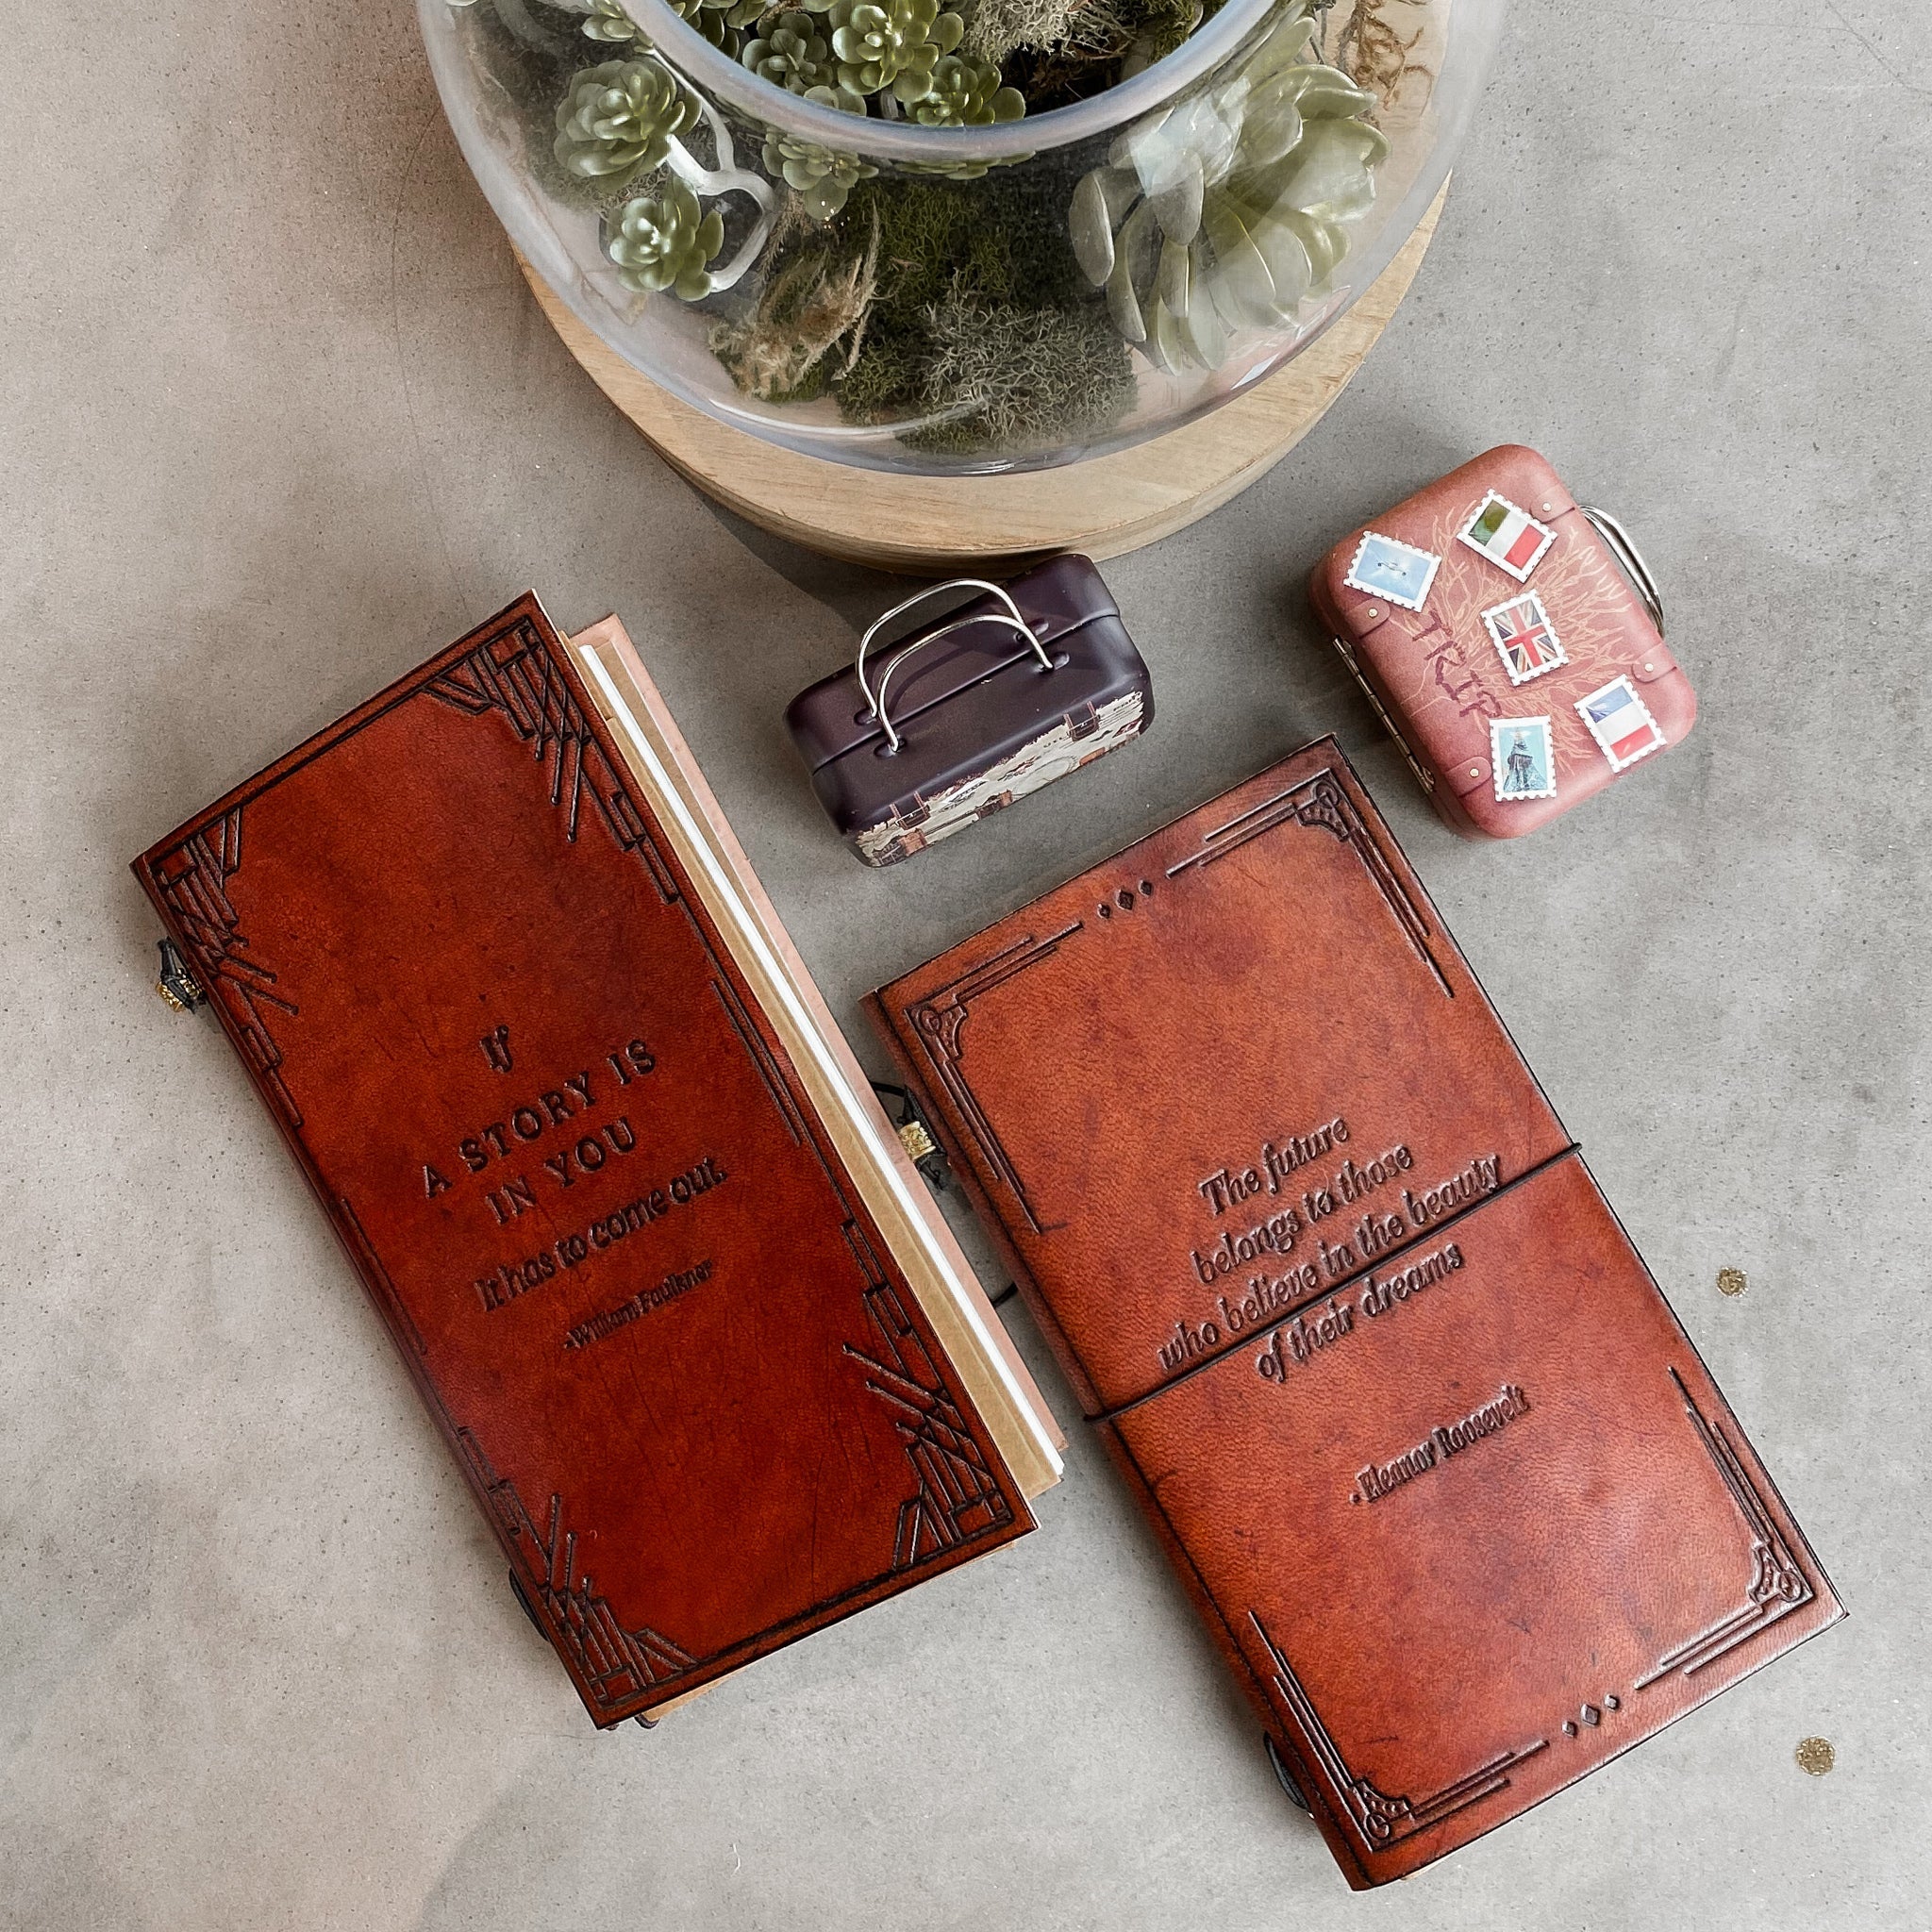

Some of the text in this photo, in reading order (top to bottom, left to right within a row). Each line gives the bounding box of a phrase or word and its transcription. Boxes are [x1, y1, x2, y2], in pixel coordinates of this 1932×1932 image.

[478, 1024, 513, 1074] If
[422, 1039, 656, 1199] A STORY IS
[485, 1116, 636, 1225] IN YOU
[1199, 1116, 1350, 1216] The future
[475, 1156, 727, 1312] It has to come out.
[1157, 1154, 1502, 1374] who believe in the beauty
[1191, 1143, 1414, 1286] belongs to those
[632, 1257, 713, 1314] Faulkner
[1256, 1242, 1466, 1384] of their dreams
[1431, 1382, 1532, 1463] Roosevelt
